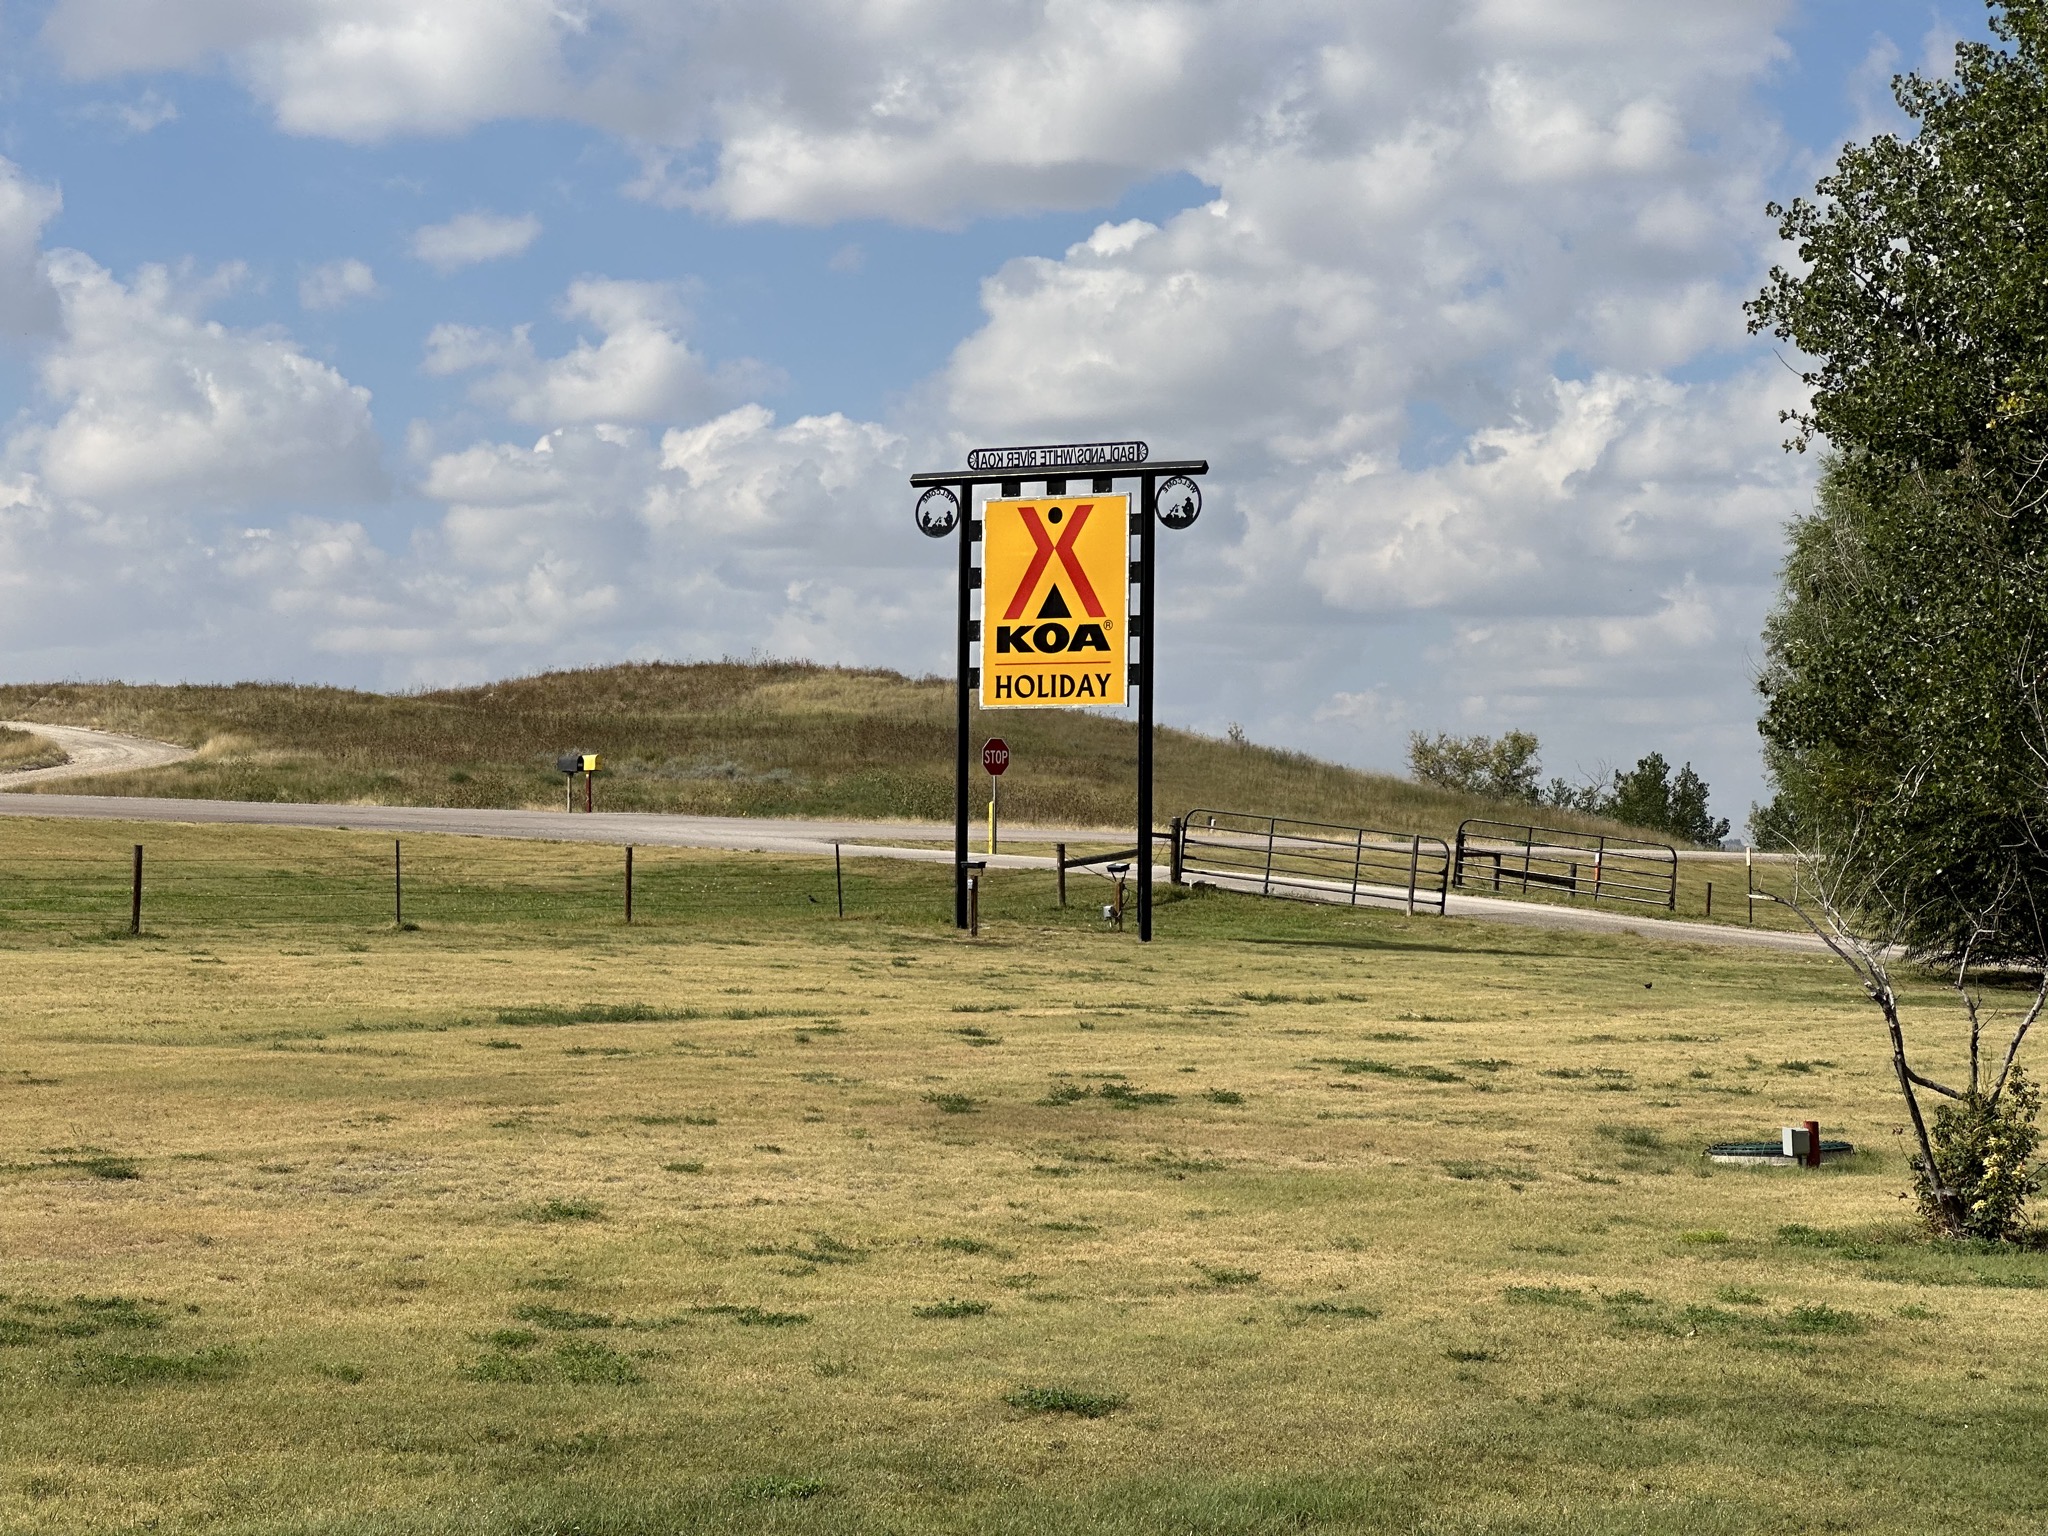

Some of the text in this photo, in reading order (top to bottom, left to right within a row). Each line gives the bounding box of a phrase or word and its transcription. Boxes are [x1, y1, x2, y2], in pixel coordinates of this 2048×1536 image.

[996, 622, 1111, 654] KOA
[995, 673, 1111, 699] HOLIDAY
[984, 749, 1008, 765] STOP
